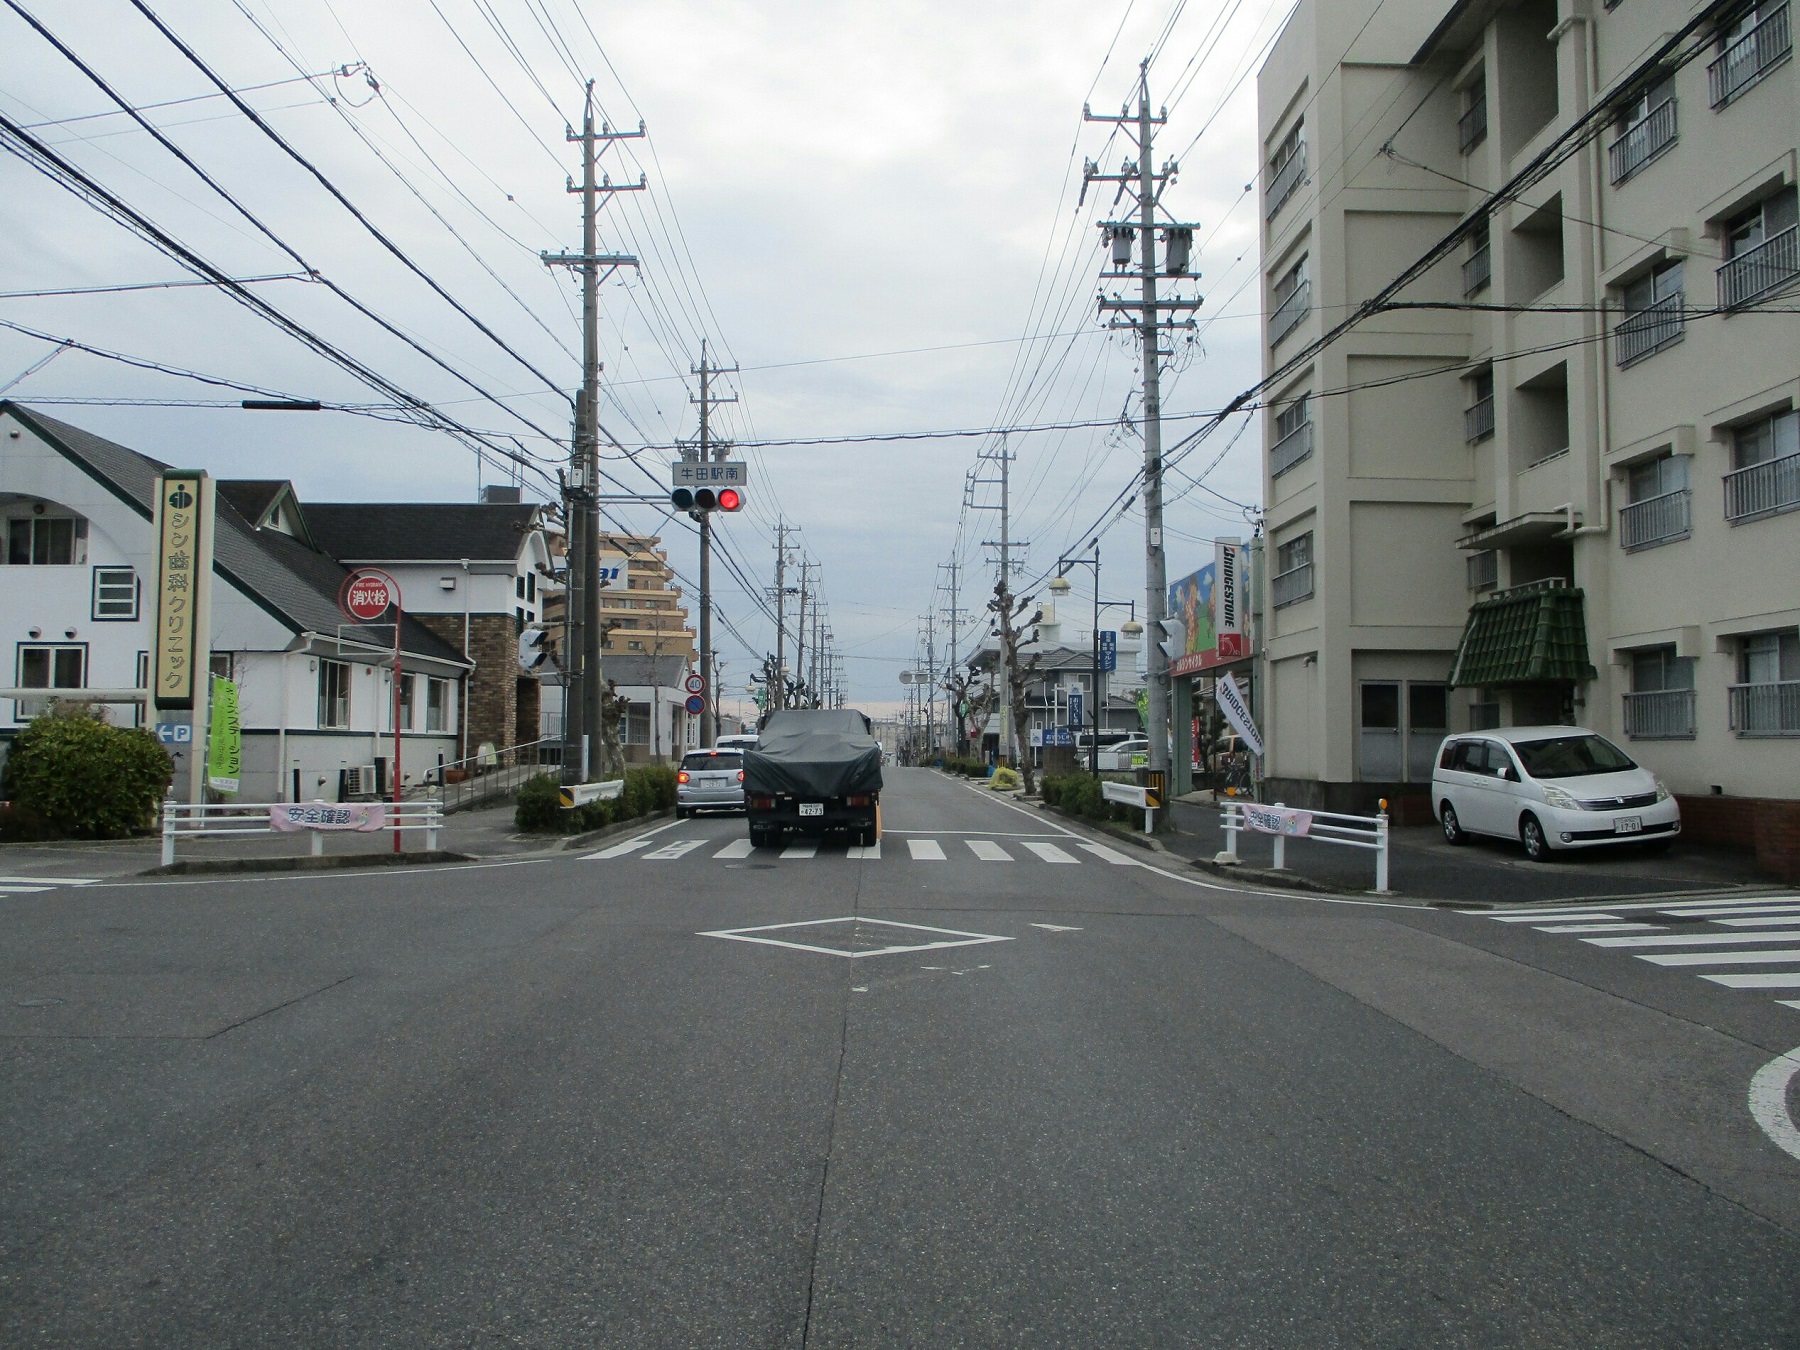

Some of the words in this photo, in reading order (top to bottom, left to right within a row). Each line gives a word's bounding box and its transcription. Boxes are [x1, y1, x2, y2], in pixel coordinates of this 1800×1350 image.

[681, 467, 738, 480] 牛田駅南
[1223, 545, 1235, 628] BRIDGESTONE
[165, 512, 190, 689] シン歯科クリニック
[352, 589, 387, 606] 消火栓
[689, 679, 701, 689] 40
[288, 806, 351, 824] 安全確認
[1248, 810, 1281, 831] 安全確認
[1621, 822, 1640, 831] 17-01
